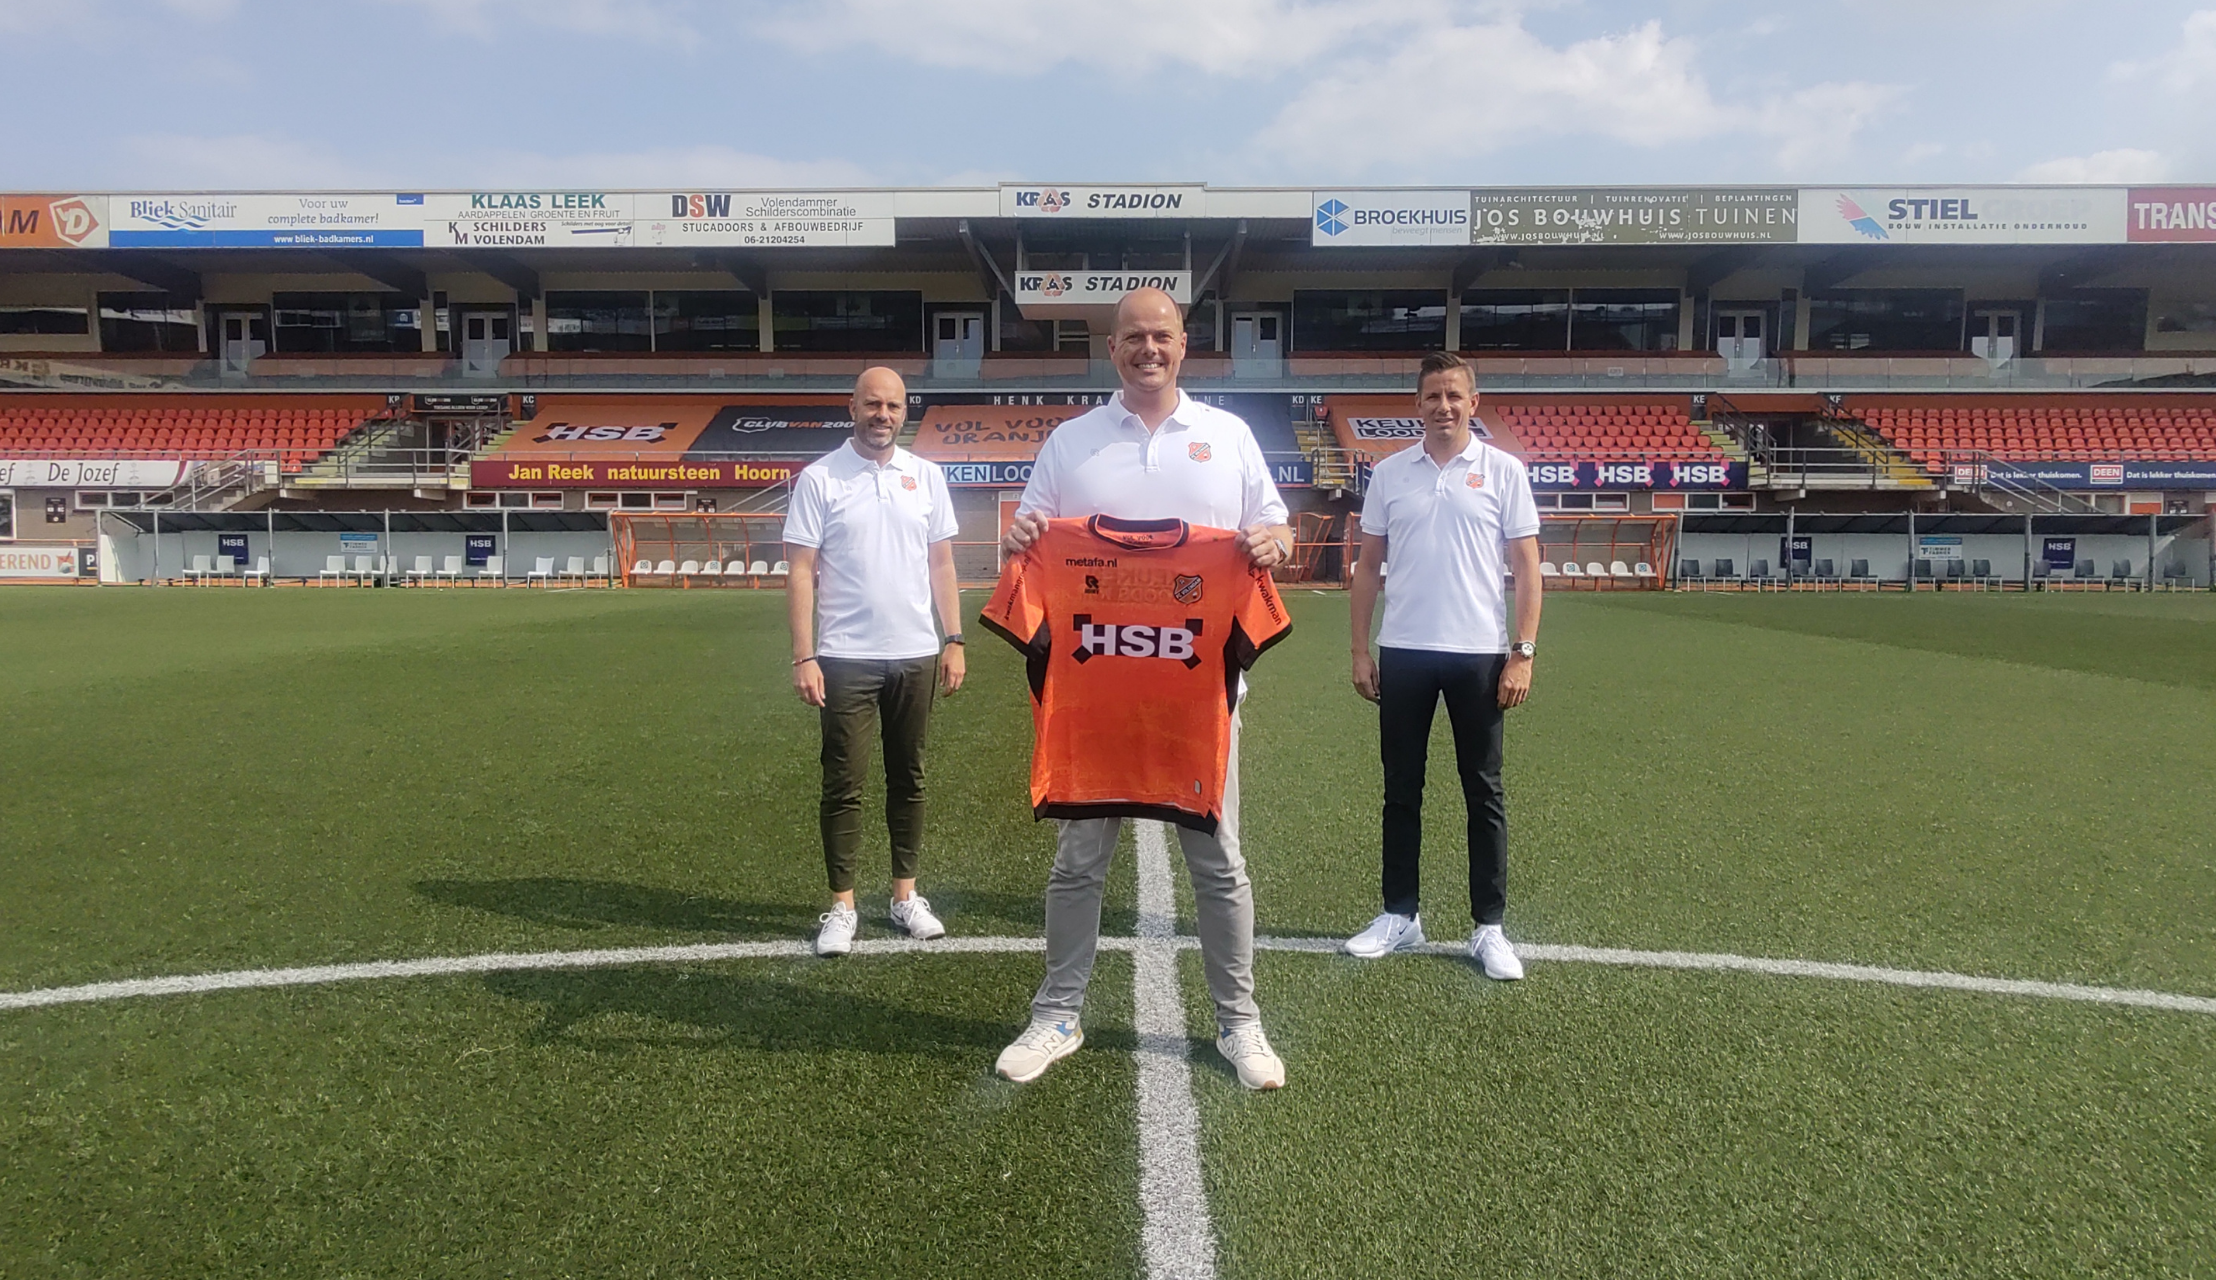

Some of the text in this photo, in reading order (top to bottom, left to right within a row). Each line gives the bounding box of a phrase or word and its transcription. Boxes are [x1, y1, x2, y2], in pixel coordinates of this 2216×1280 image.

[299, 199, 349, 209] Voor uw
[471, 194, 606, 209] KLAAS LEEK
[761, 198, 837, 207] Volendammer
[1016, 191, 1182, 209] KRAS STADION
[1475, 195, 1577, 203] TUINARCHITECTUUR
[1605, 195, 1687, 203] TUINRENOVATIE
[130, 200, 237, 219] Bliek Sanitair
[672, 194, 731, 218] DSW
[1888, 198, 1978, 220] STIEL
[458, 210, 620, 219] AARDAPPELEN GROENTE EN FRUIT
[746, 206, 856, 218] Schilderscombinatie
[1354, 209, 1467, 225] BROEKHUIS
[268, 213, 379, 227] complete badkamer!
[1474, 208, 1797, 230] JOS BOUWHUIS TUINEN
[474, 221, 547, 232] SCHILDERS
[682, 221, 864, 232] STUCADOORS & AFBOUWBEDRIJF
[1392, 226, 1429, 235] beweegt
[474, 234, 545, 245] VOLENDAM
[744, 235, 805, 244] 06-21204254
[1020, 277, 1178, 291] KRAS STADION
[523, 395, 535, 404] KC
[909, 395, 922, 404] KD
[994, 395, 1044, 405] HENK
[1292, 395, 1305, 404] KD
[1310, 395, 1322, 404] KE
[1693, 395, 1705, 404] KE
[935, 416, 1075, 433] VOL VOO
[546, 425, 665, 441] HSB
[1361, 428, 1425, 438] LOOD
[48, 462, 120, 484] De Jozef
[509, 464, 791, 480] Jan Reek natuursteen Hoorn
[1598, 466, 1651, 483] HSB
[1673, 466, 1726, 483] HSB
[2093, 468, 2120, 477] DEEN
[2127, 471, 2138, 479] Dat
[2139, 471, 2147, 479] is
[222, 539, 245, 547] HSB
[470, 540, 491, 548] HSB
[1066, 557, 1117, 568] metafa.nl
[1255, 574, 1282, 626] kwakman
[1081, 623, 1194, 660] HSB
